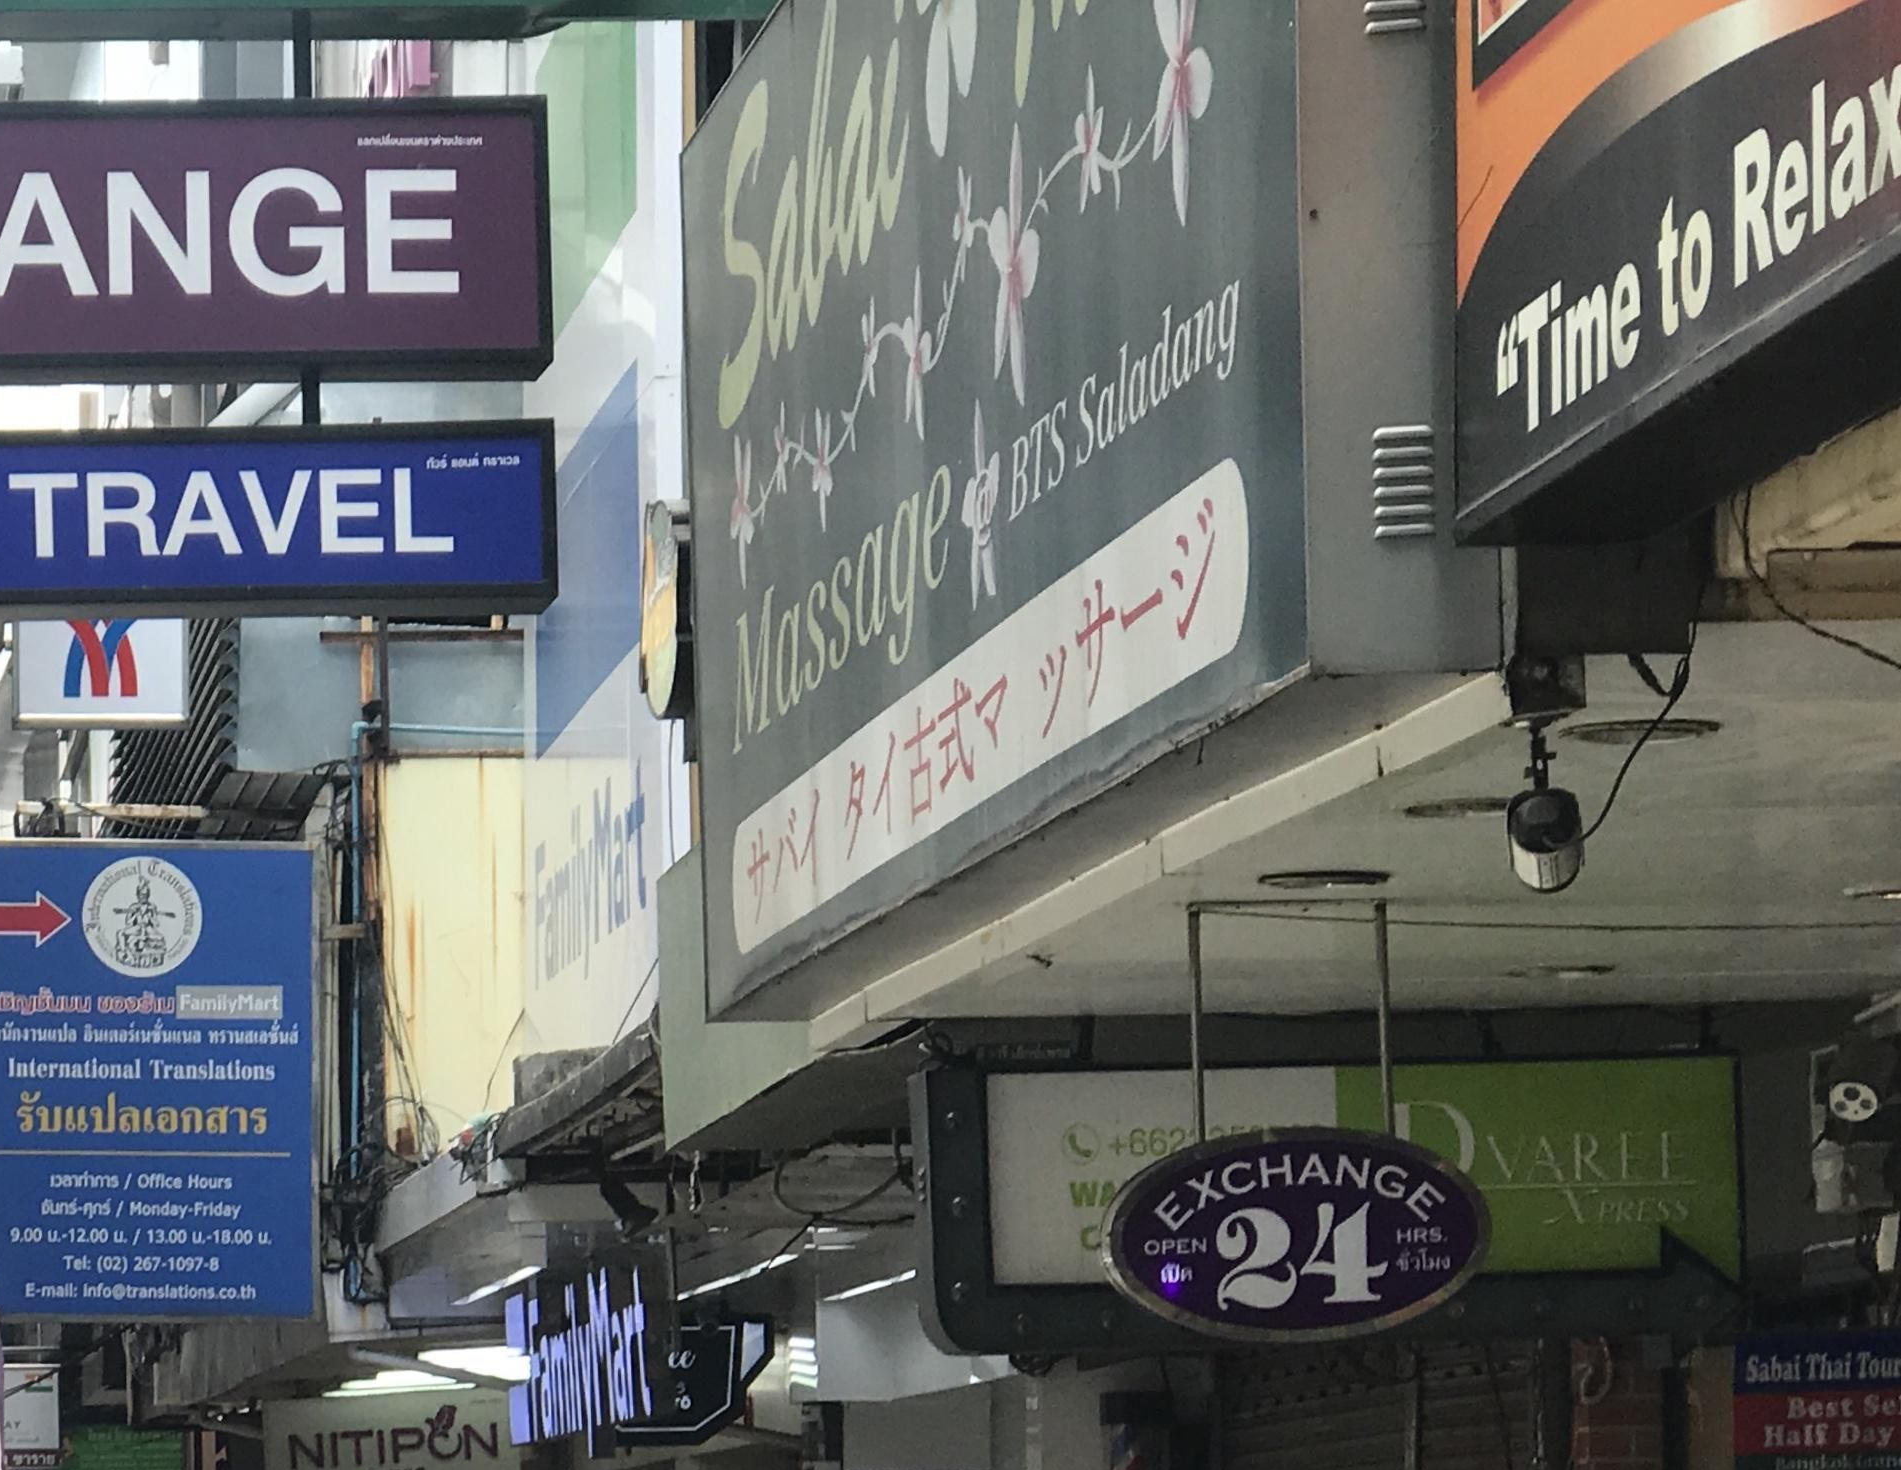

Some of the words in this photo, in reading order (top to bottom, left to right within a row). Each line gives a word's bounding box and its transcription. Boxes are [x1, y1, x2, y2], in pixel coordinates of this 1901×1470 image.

[718, 0, 910, 430] Sabai
[1658, 195, 1713, 337] to
[1733, 62, 1901, 289] Relax
[1008, 398, 1067, 523] BTS
[1075, 279, 1240, 469] Saladang
[8, 467, 455, 558] TRAVEL
[732, 464, 951, 755] Massage
[534, 757, 647, 991] FamilyMart
[179, 993, 280, 1015] FamilyMart
[8, 1057, 141, 1080] International
[150, 1058, 276, 1081] Translations
[16, 1090, 268, 1135] รับแปลเอกสาร
[137, 1173, 183, 1190] Office
[188, 1174, 233, 1190] Hours
[1154, 1152, 1446, 1232] EXCHANGE
[129, 1201, 242, 1220] Monday-Friday
[9, 1227, 43, 1243] 9.00
[147, 1228, 187, 1245] 13.00
[1144, 1237, 1207, 1257] OPEN
[1215, 1201, 1389, 1311] 24
[1396, 1228, 1448, 1245] HRS.
[63, 1255, 92, 1270] Tel:
[96, 1255, 129, 1274] (02)
[133, 1256, 220, 1272] 267-1097-8
[25, 1283, 78, 1298] E-mail:
[82, 1283, 257, 1300] info@translations.co.th
[528, 1265, 652, 1459] FamilyMart
[1745, 1352, 1801, 1384] Sabai
[1805, 1351, 1852, 1382] Thai
[1787, 1395, 1855, 1420] Best
[288, 1416, 499, 1470] NITIPON
[1763, 1422, 1829, 1449] Half
[1838, 1421, 1895, 1448] Day
